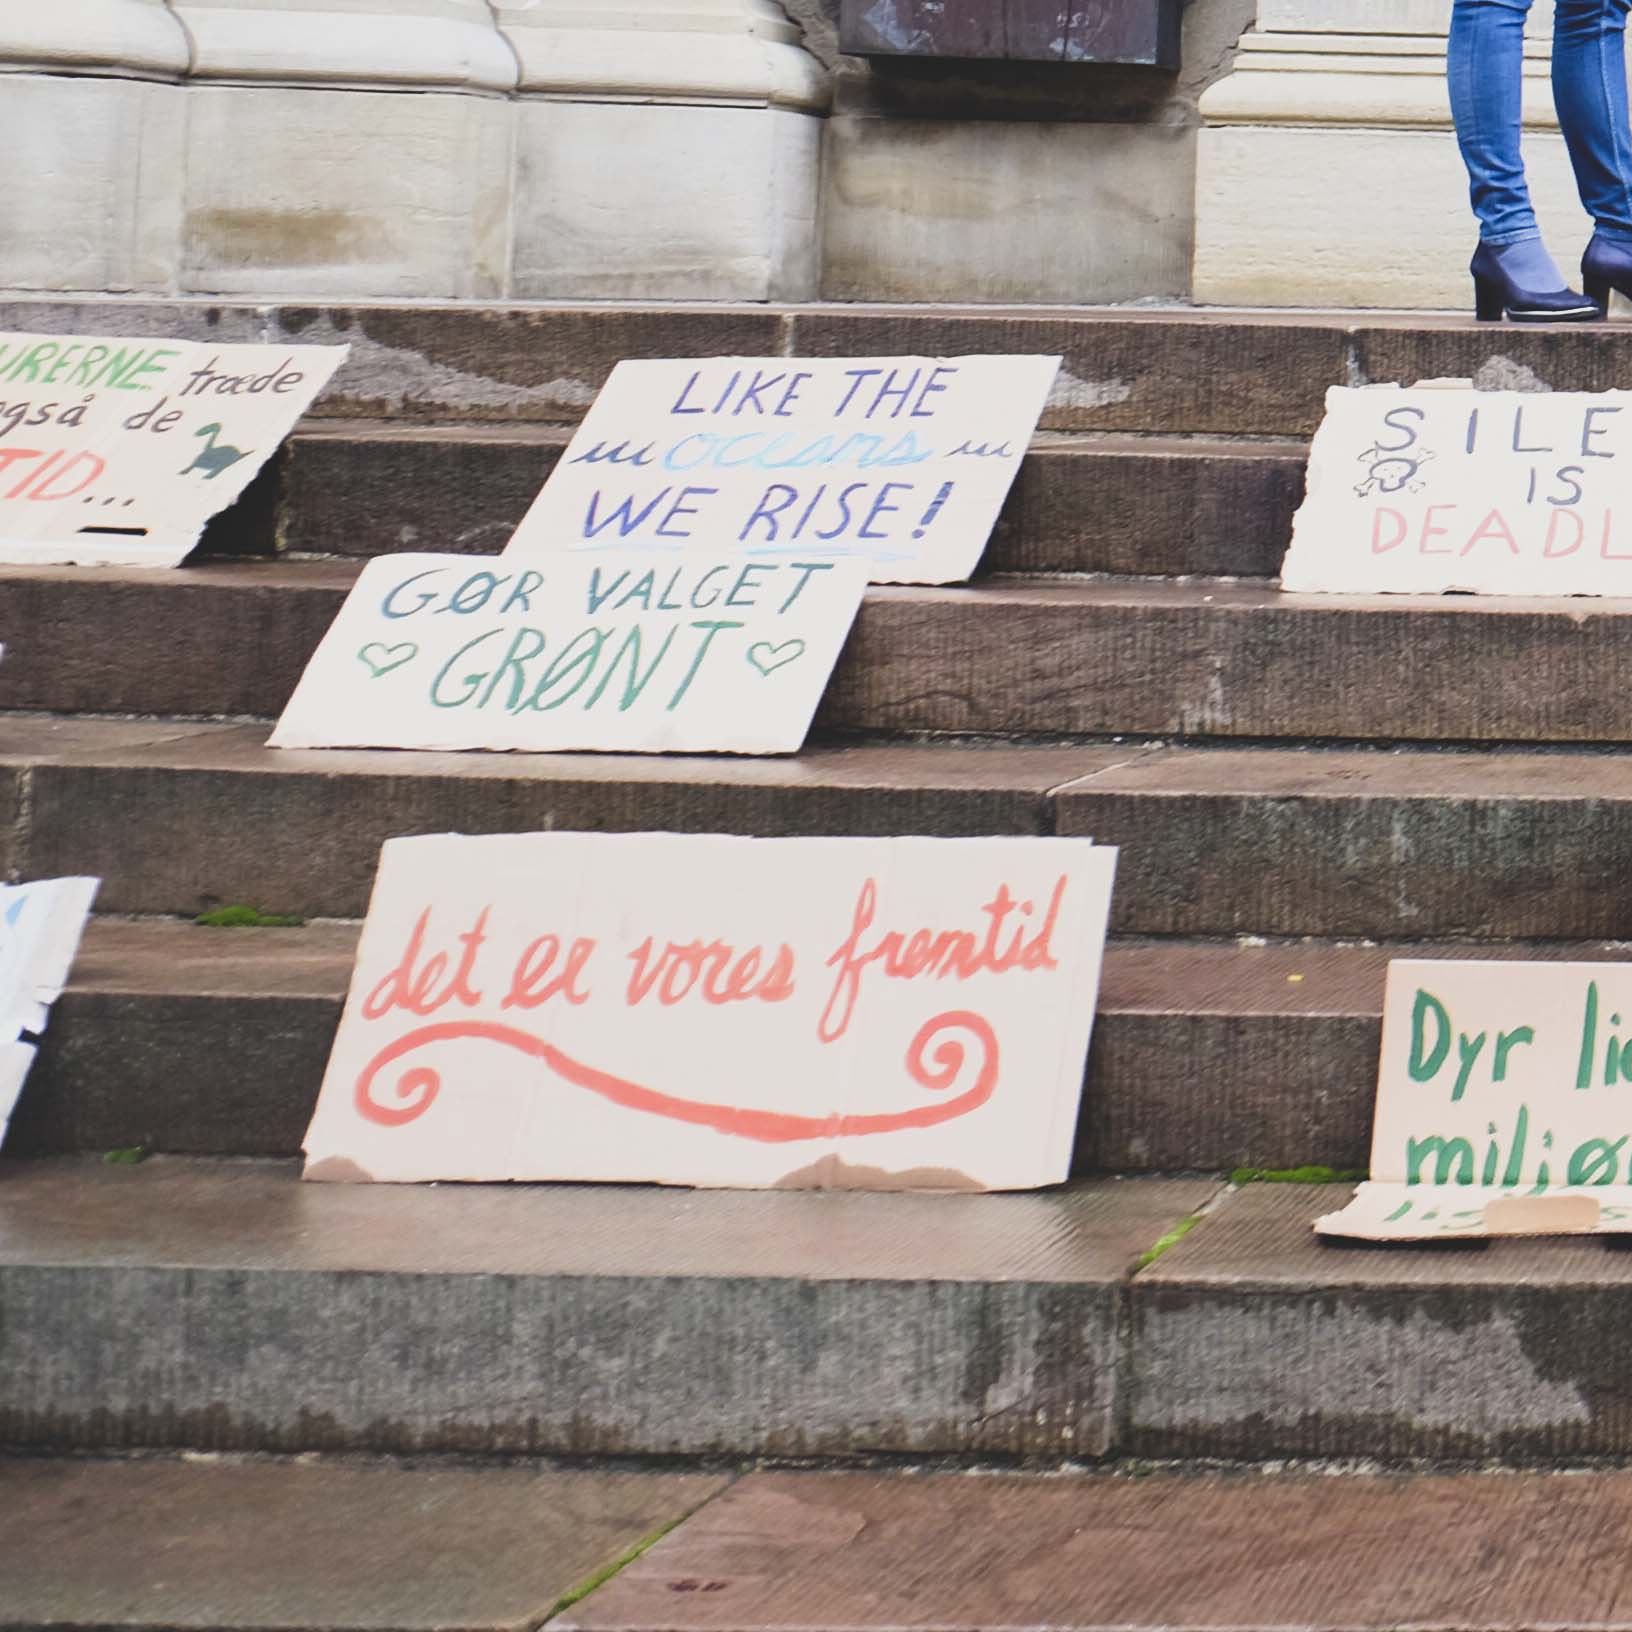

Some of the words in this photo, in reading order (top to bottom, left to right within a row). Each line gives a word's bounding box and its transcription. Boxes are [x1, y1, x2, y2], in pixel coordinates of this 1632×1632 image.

[122, 396, 183, 433] de
[670, 370, 812, 417] LIKE
[833, 367, 958, 419] THE
[581, 486, 718, 538] WE
[739, 480, 955, 541] RISE!
[1528, 464, 1585, 507] IS
[382, 567, 545, 619] GØR
[587, 562, 835, 615] VALGET
[430, 620, 746, 716] GRØNT
[361, 904, 491, 1021] det
[500, 932, 599, 1010] er
[625, 934, 797, 1006] vores
[816, 874, 1069, 1044] fremtid
[1407, 987, 1535, 1102] Dyr
